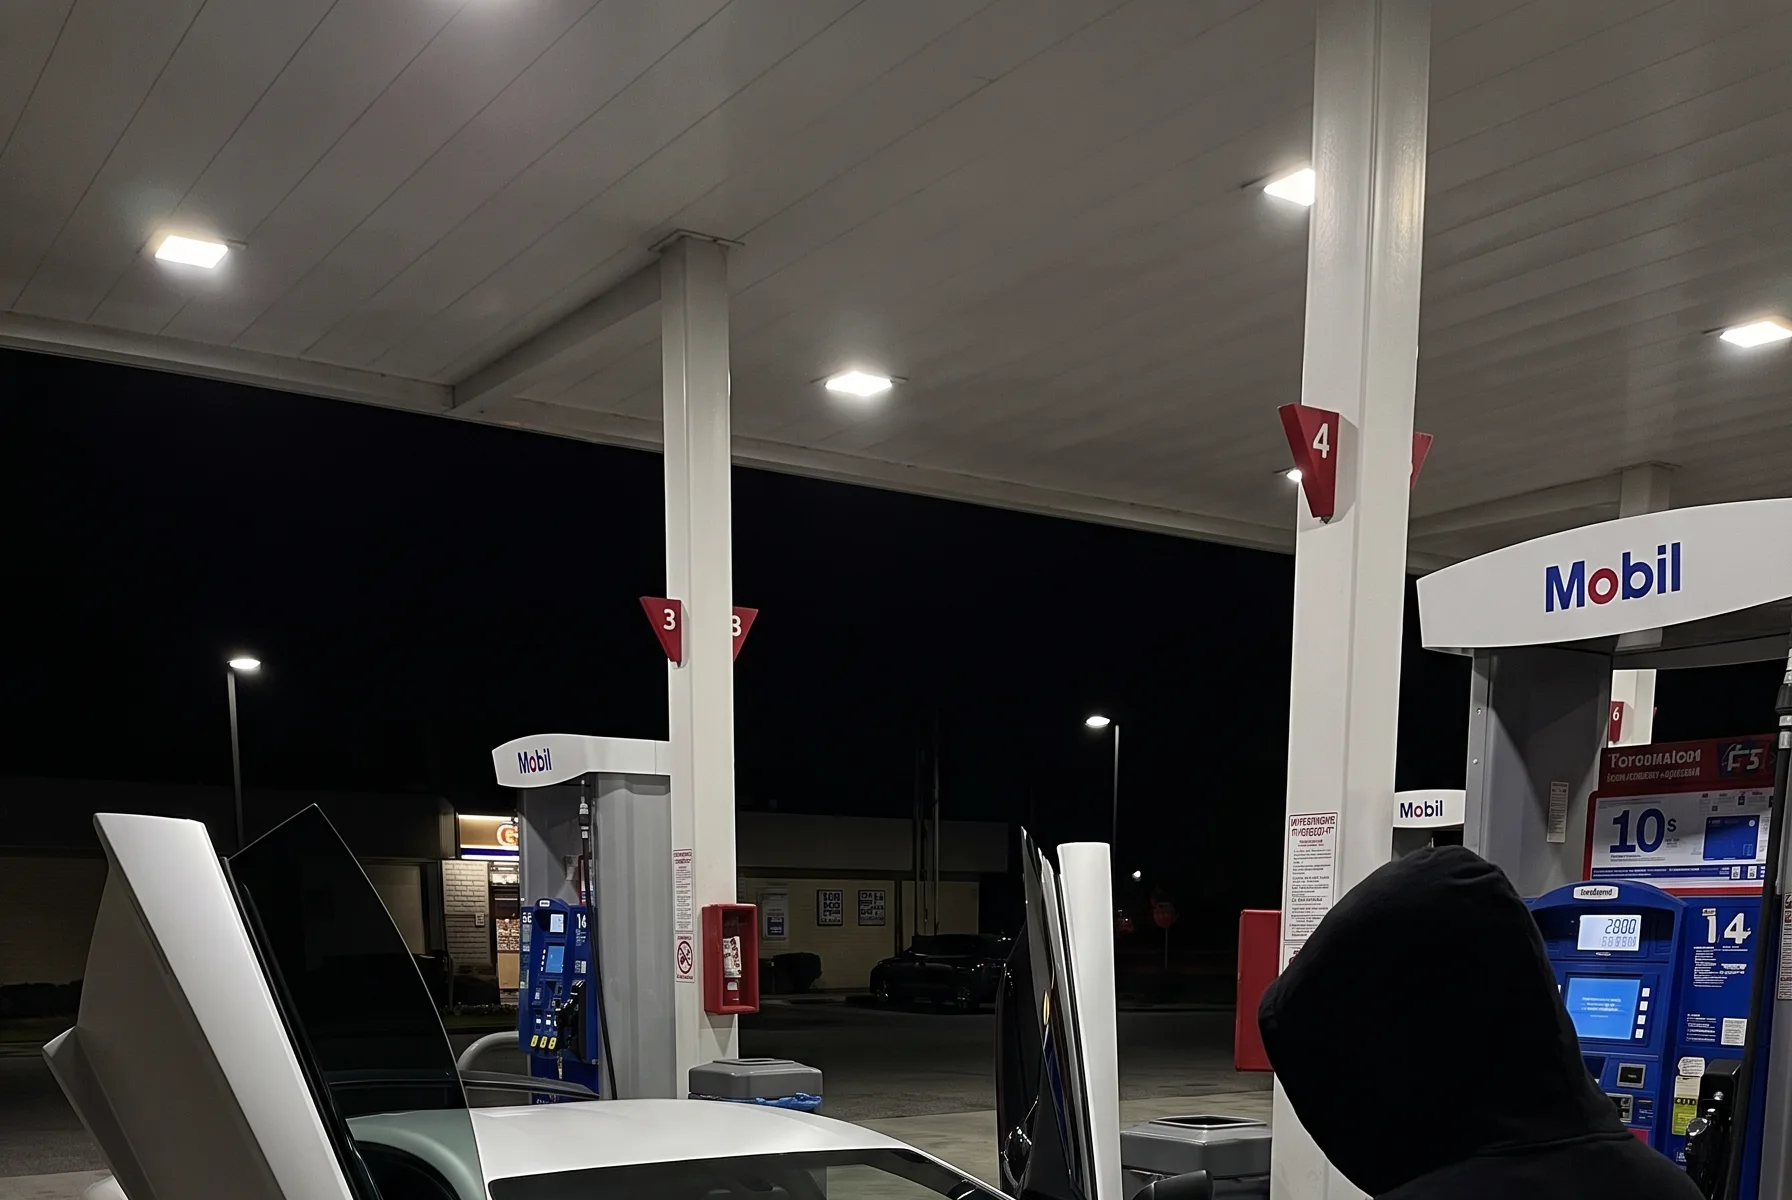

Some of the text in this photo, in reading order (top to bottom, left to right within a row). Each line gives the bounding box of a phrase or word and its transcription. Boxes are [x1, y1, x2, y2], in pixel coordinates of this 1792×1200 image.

[1313, 423, 1330, 459] 4
[1545, 541, 1681, 613] Mobil
[663, 608, 676, 631] 3
[1612, 706, 1620, 721] 6
[517, 748, 552, 774] Mobil
[1400, 800, 1443, 818] Mobil
